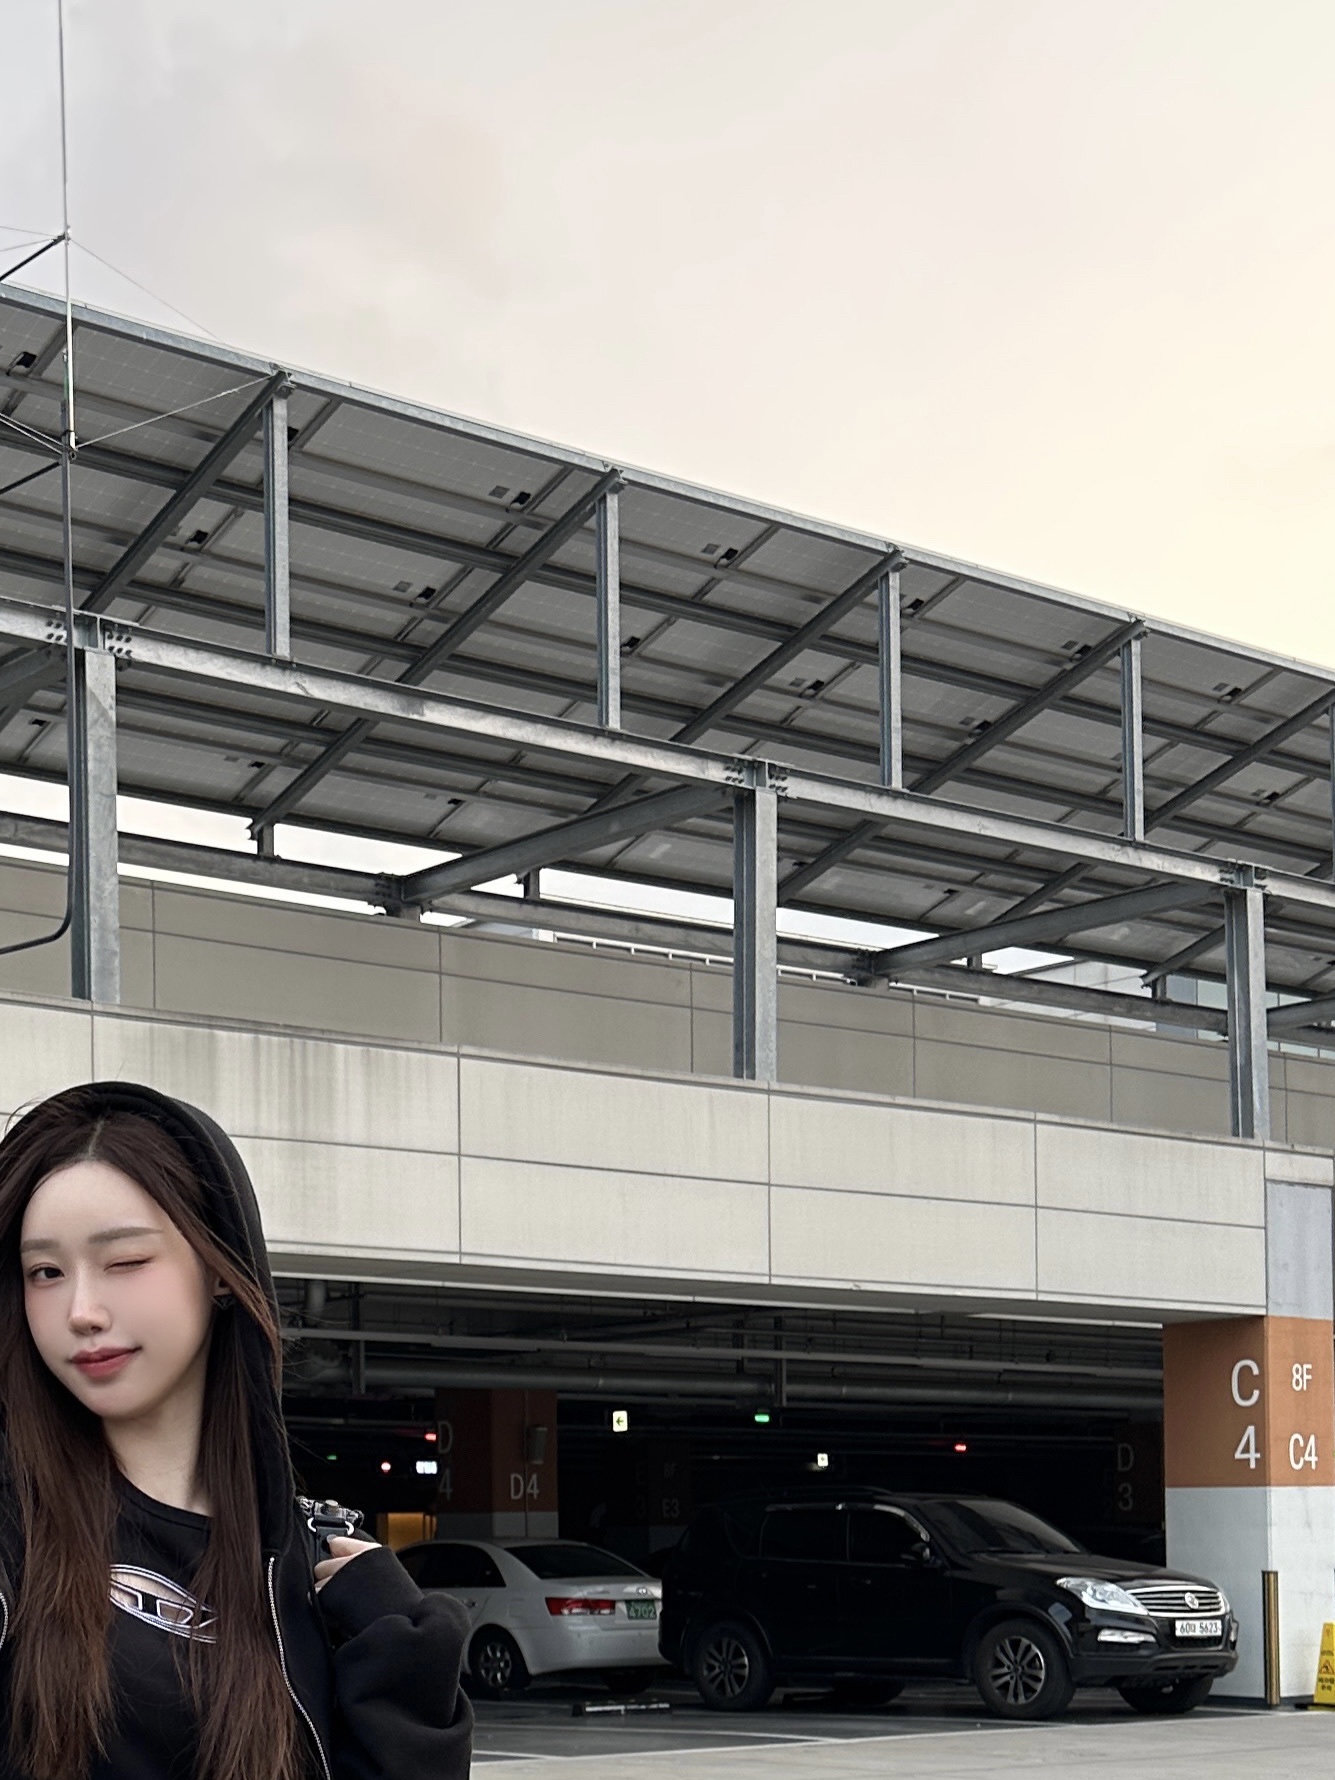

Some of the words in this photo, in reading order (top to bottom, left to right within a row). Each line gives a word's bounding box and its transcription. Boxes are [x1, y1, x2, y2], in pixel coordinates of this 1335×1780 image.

[1230, 1358, 1260, 1408] C
[1291, 1362, 1313, 1392] 8F
[1233, 1424, 1261, 1470] 4
[1288, 1432, 1319, 1471] C4
[509, 1472, 540, 1501] D4
